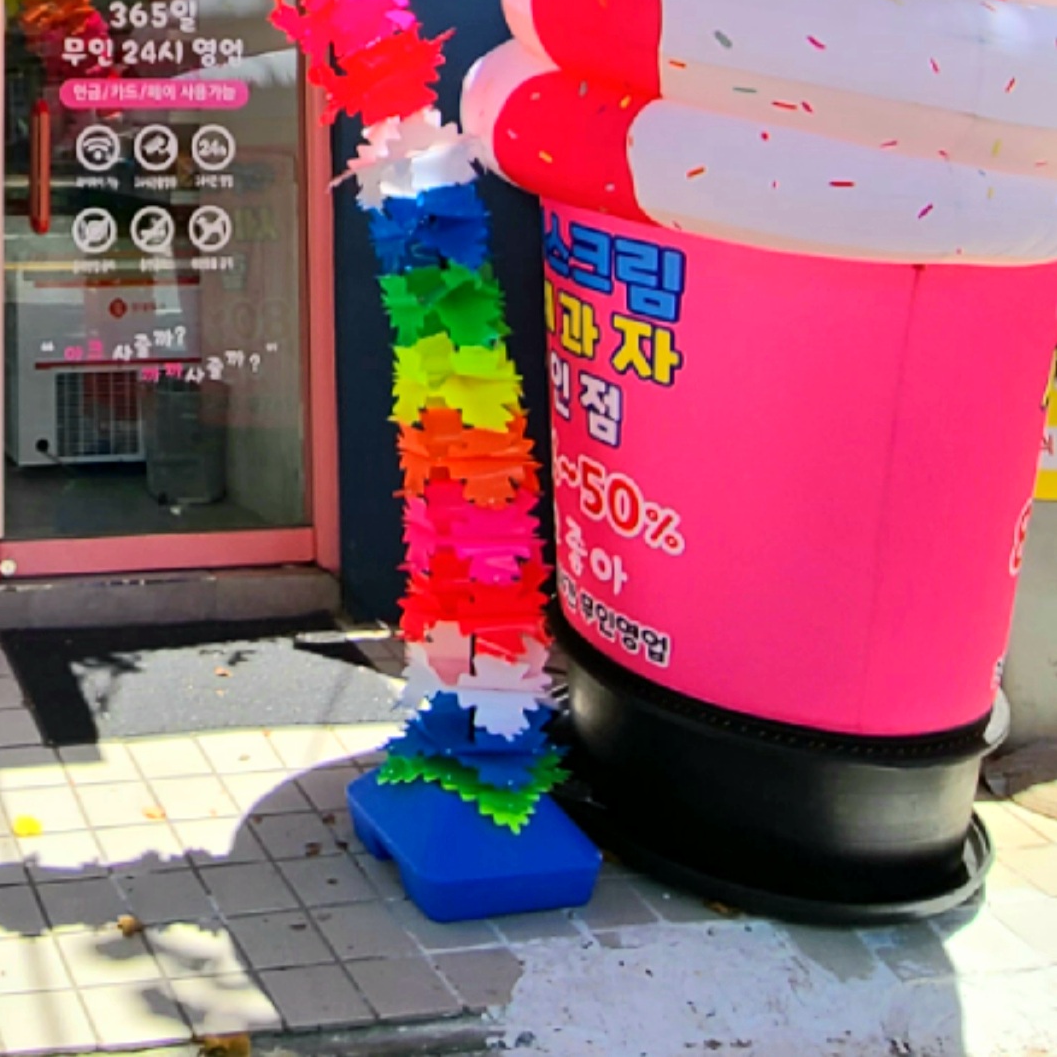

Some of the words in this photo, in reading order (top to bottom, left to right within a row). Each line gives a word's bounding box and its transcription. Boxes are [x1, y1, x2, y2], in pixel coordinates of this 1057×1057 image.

[62, 37, 114, 67] 무인
[121, 39, 184, 65] 24시
[192, 37, 244, 68] 영업
[544, 279, 683, 388] 과자
